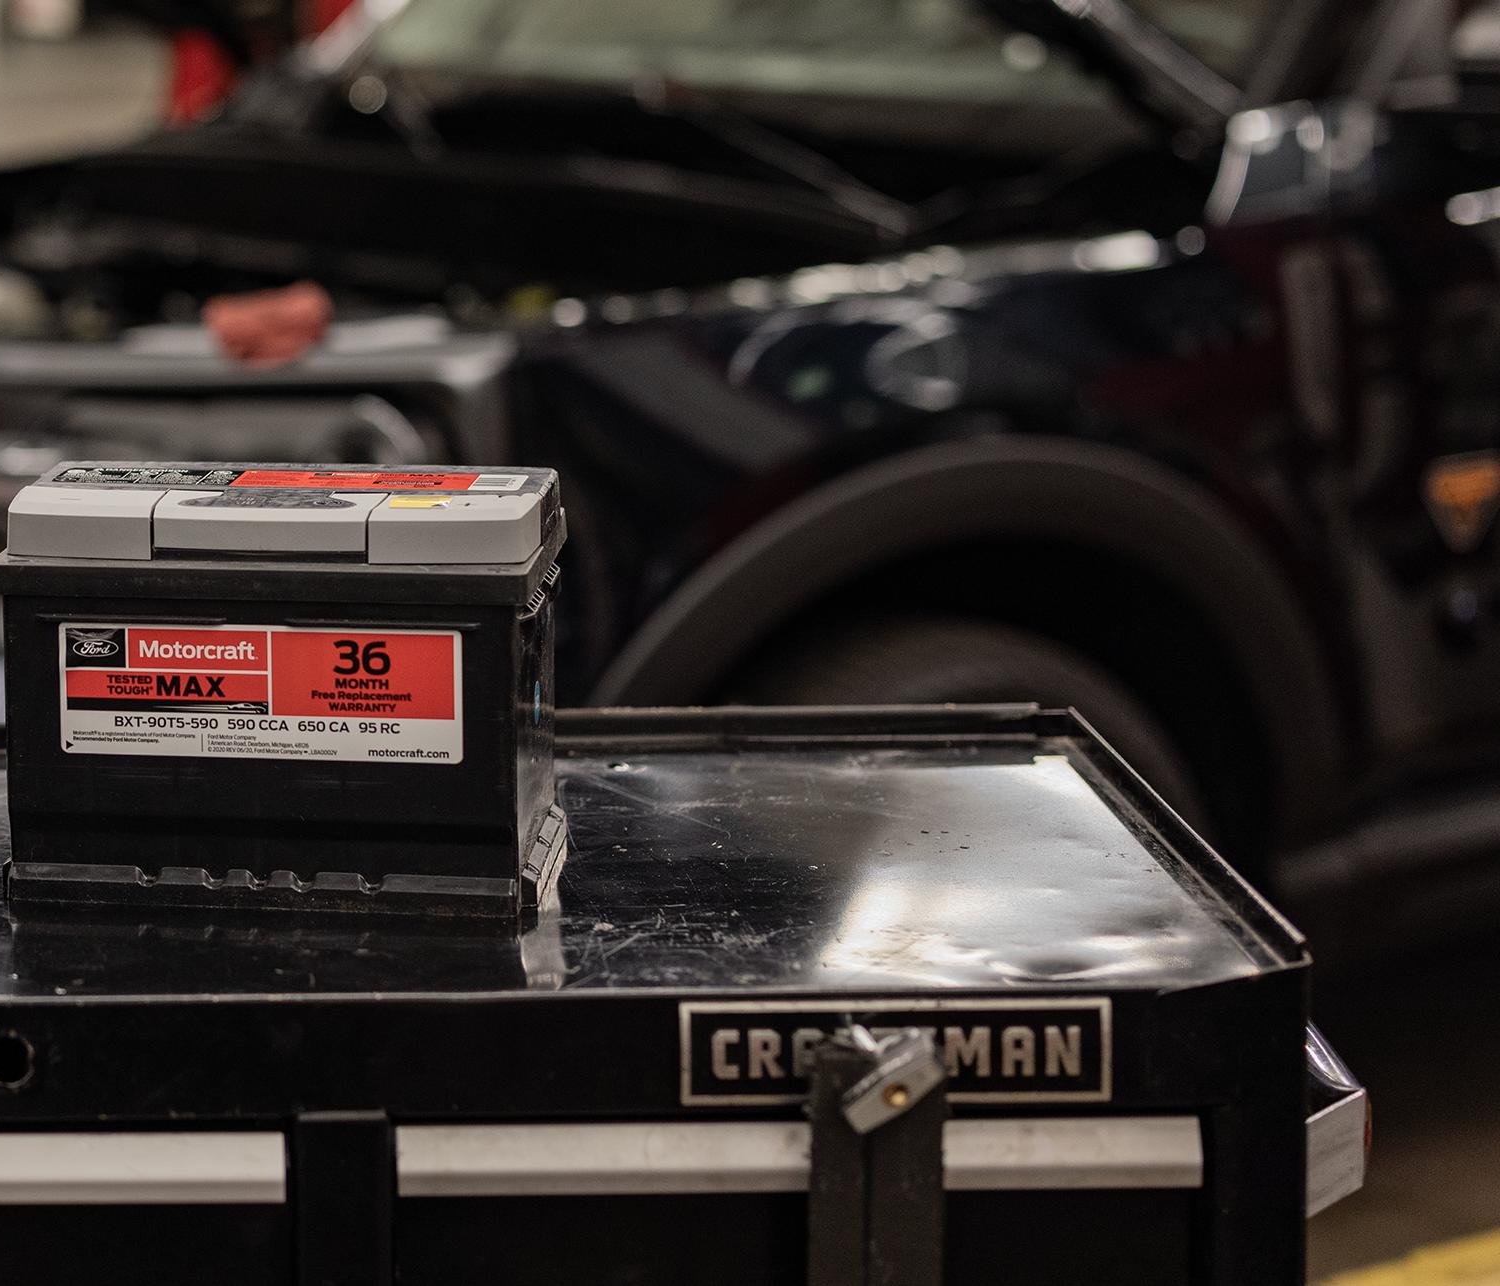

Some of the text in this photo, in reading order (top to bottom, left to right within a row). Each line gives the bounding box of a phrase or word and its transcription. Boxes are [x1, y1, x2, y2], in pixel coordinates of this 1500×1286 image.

[80, 640, 110, 654] Ford
[139, 639, 257, 660] Motorcraft
[333, 640, 391, 676] 36
[106, 674, 153, 685] TESTED
[156, 675, 226, 697] MAX
[335, 678, 389, 690] MONTH
[311, 690, 412, 702] Free Replacement
[329, 702, 396, 713] WARRANTY
[114, 716, 400, 735] BXT-90T5-590 590 CCA 650 CA 95 RC
[368, 748, 450, 759] motorcraft.com
[710, 1024, 1082, 1080] CRAMAN
